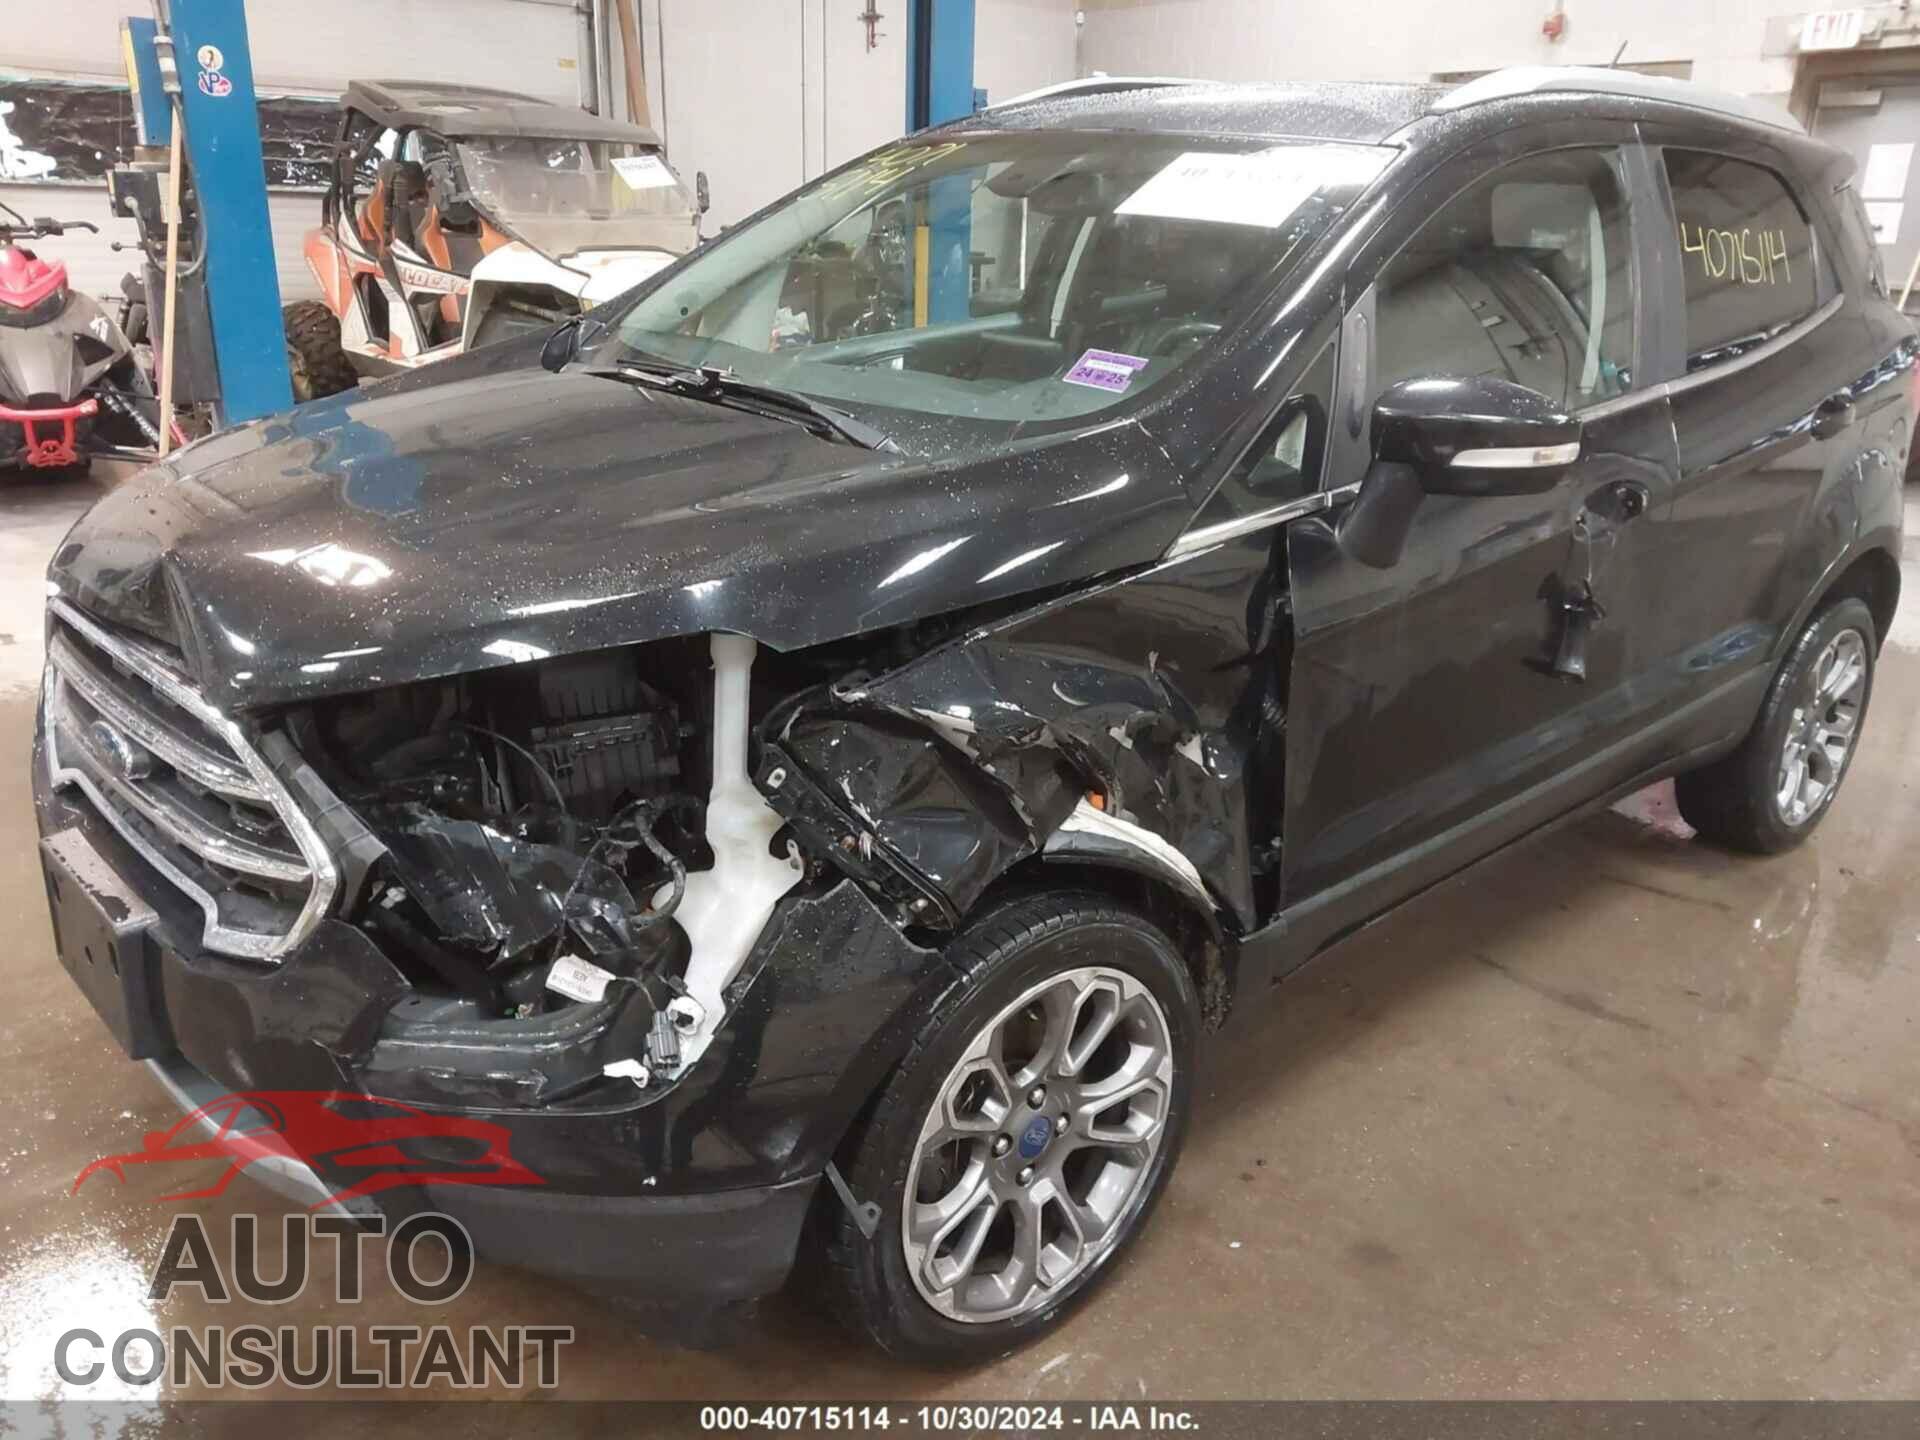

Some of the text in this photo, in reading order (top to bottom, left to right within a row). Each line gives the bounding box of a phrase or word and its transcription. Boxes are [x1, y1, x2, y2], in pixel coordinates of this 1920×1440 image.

[1680, 221, 1792, 285] 40715114
[1076, 366, 1095, 378] 24
[1105, 372, 1126, 385] 25
